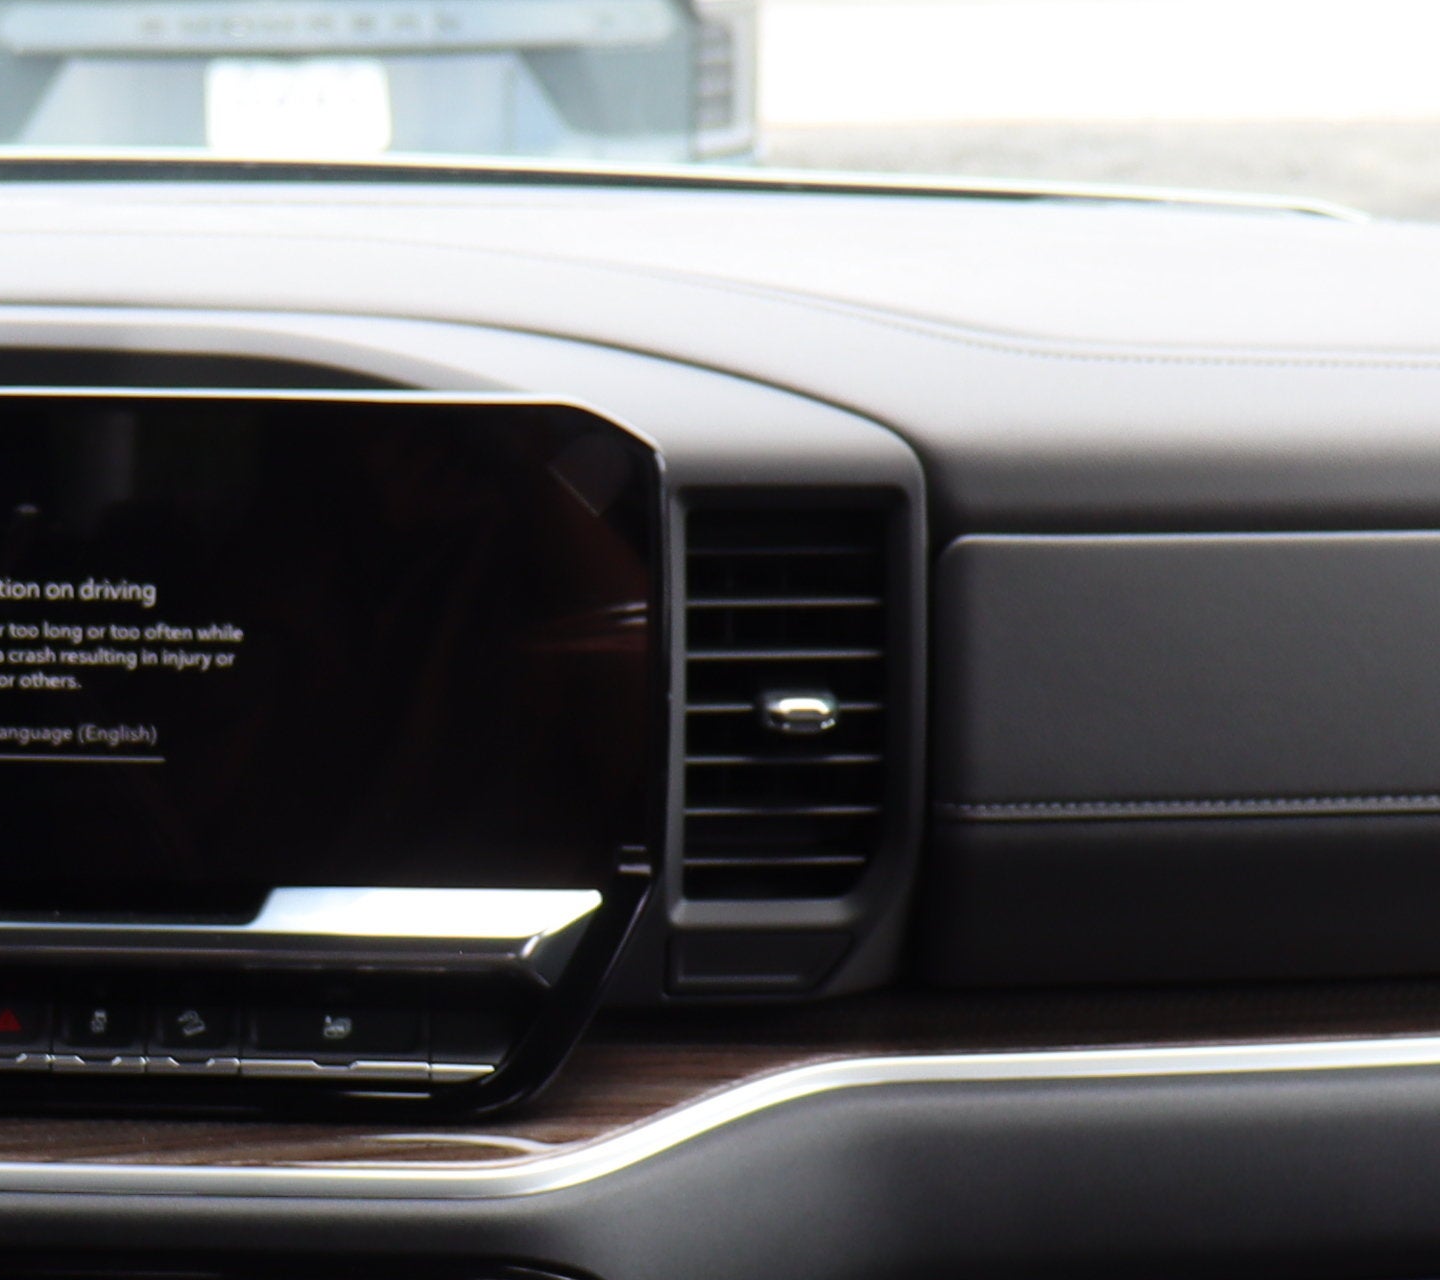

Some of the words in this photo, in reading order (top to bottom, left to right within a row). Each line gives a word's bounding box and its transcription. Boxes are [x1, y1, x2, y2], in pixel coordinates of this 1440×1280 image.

[46, 584, 74, 600] on
[80, 578, 157, 608] driving
[9, 622, 40, 638] too
[43, 620, 83, 644] long
[87, 626, 105, 639] or
[110, 623, 141, 640] too
[144, 622, 193, 640] often
[197, 623, 244, 642] while
[8, 646, 56, 663] crash
[60, 648, 138, 670] resulting
[141, 648, 158, 665] in
[162, 649, 212, 671] injury
[215, 652, 235, 666] or
[20, 672, 82, 689] others.
[79, 724, 157, 746] (English)
